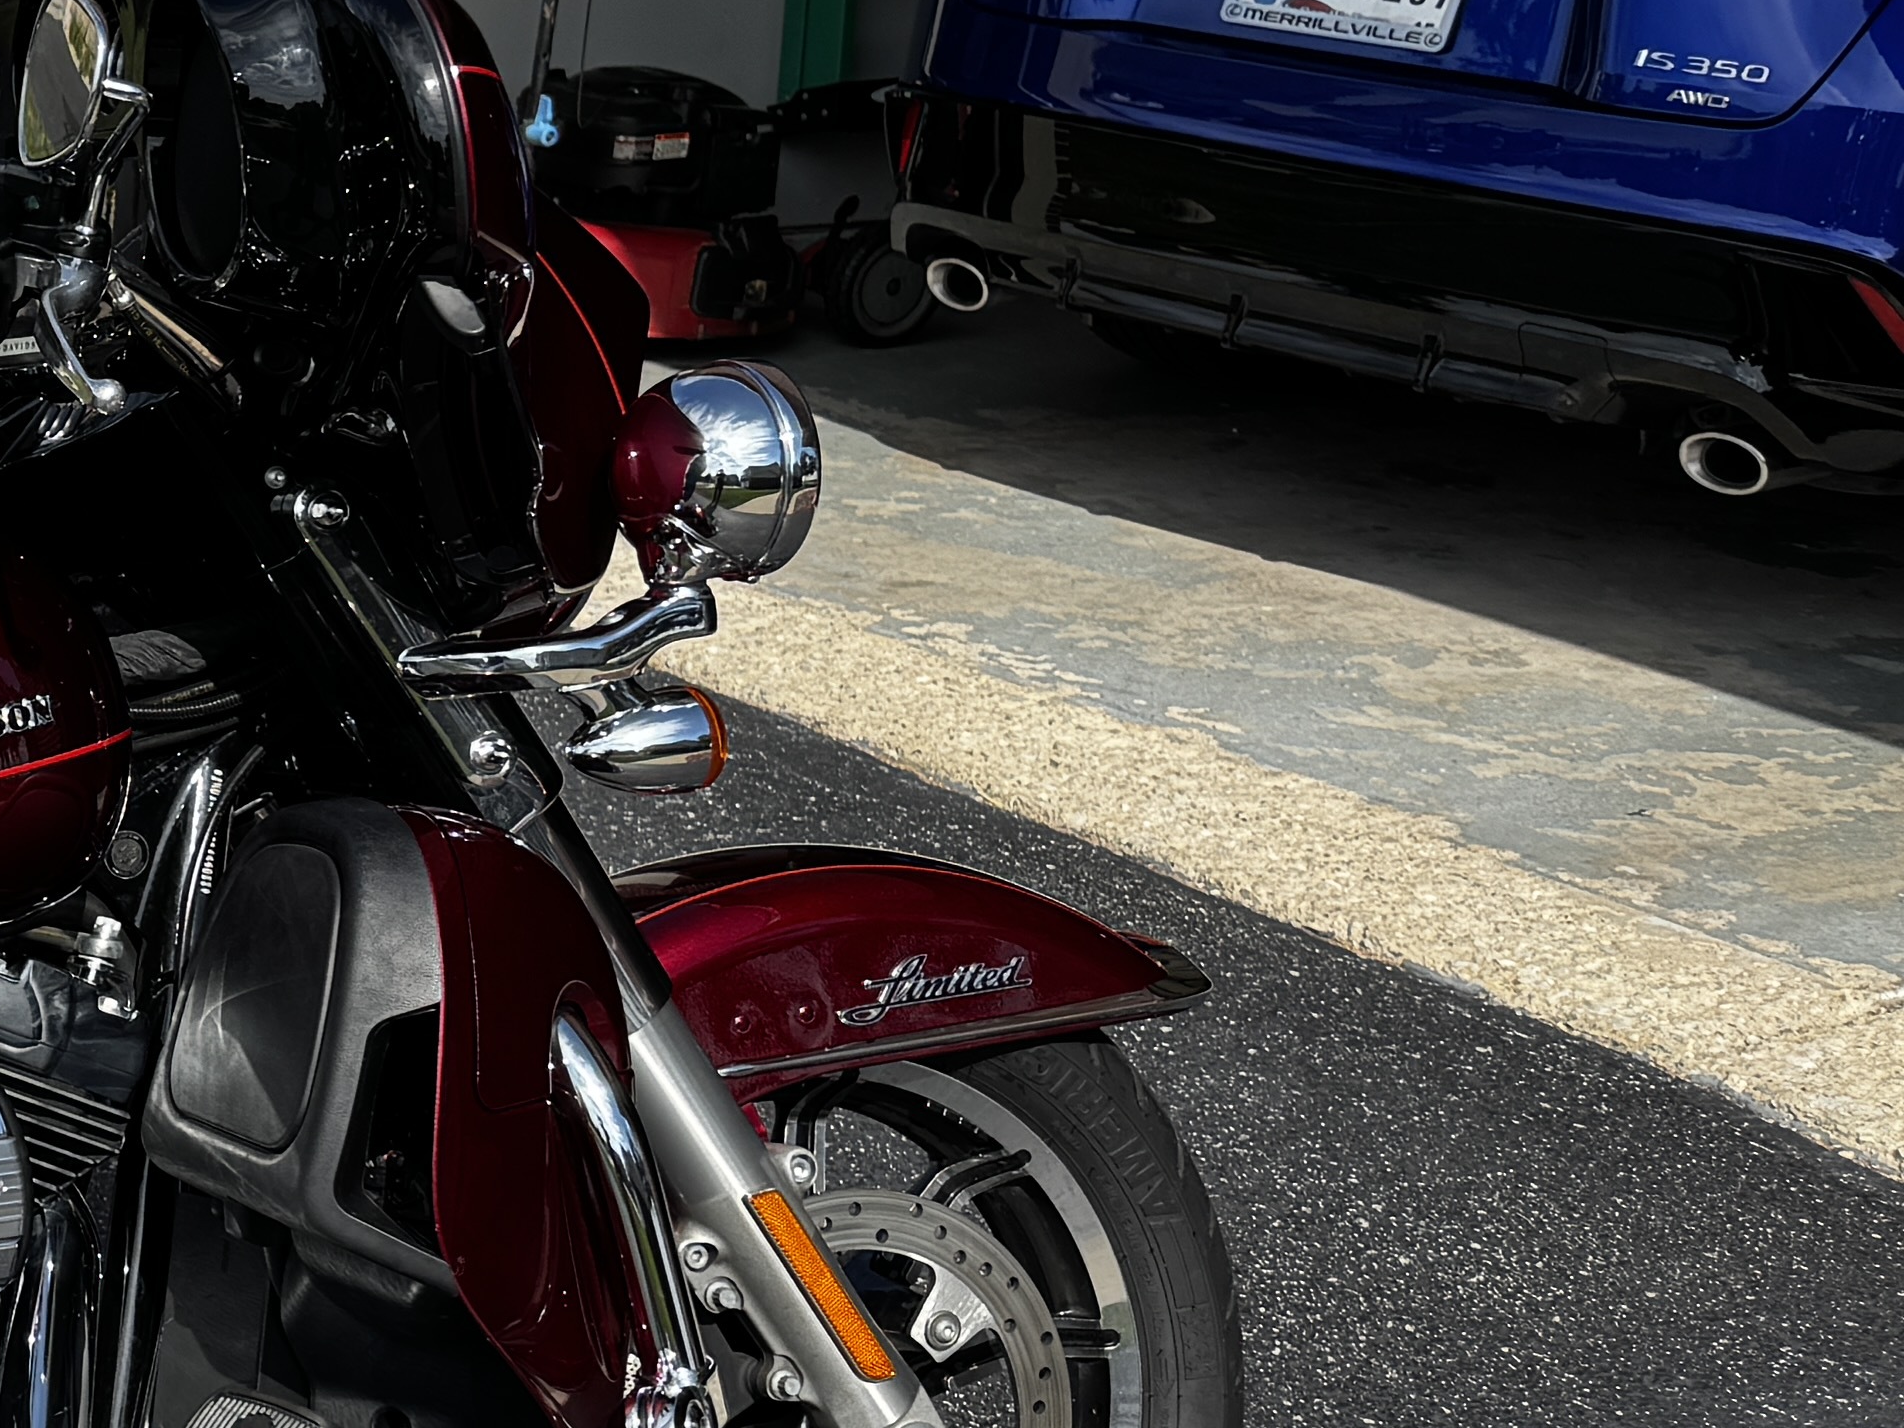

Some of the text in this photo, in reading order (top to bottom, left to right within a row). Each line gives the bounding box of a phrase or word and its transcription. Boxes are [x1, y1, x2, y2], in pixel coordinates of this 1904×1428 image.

[1243, 7, 1422, 45] MERRILLVILLE
[1633, 48, 1771, 84] IS 350
[1666, 89, 1731, 109] AWD
[835, 953, 1033, 1027] Limited
